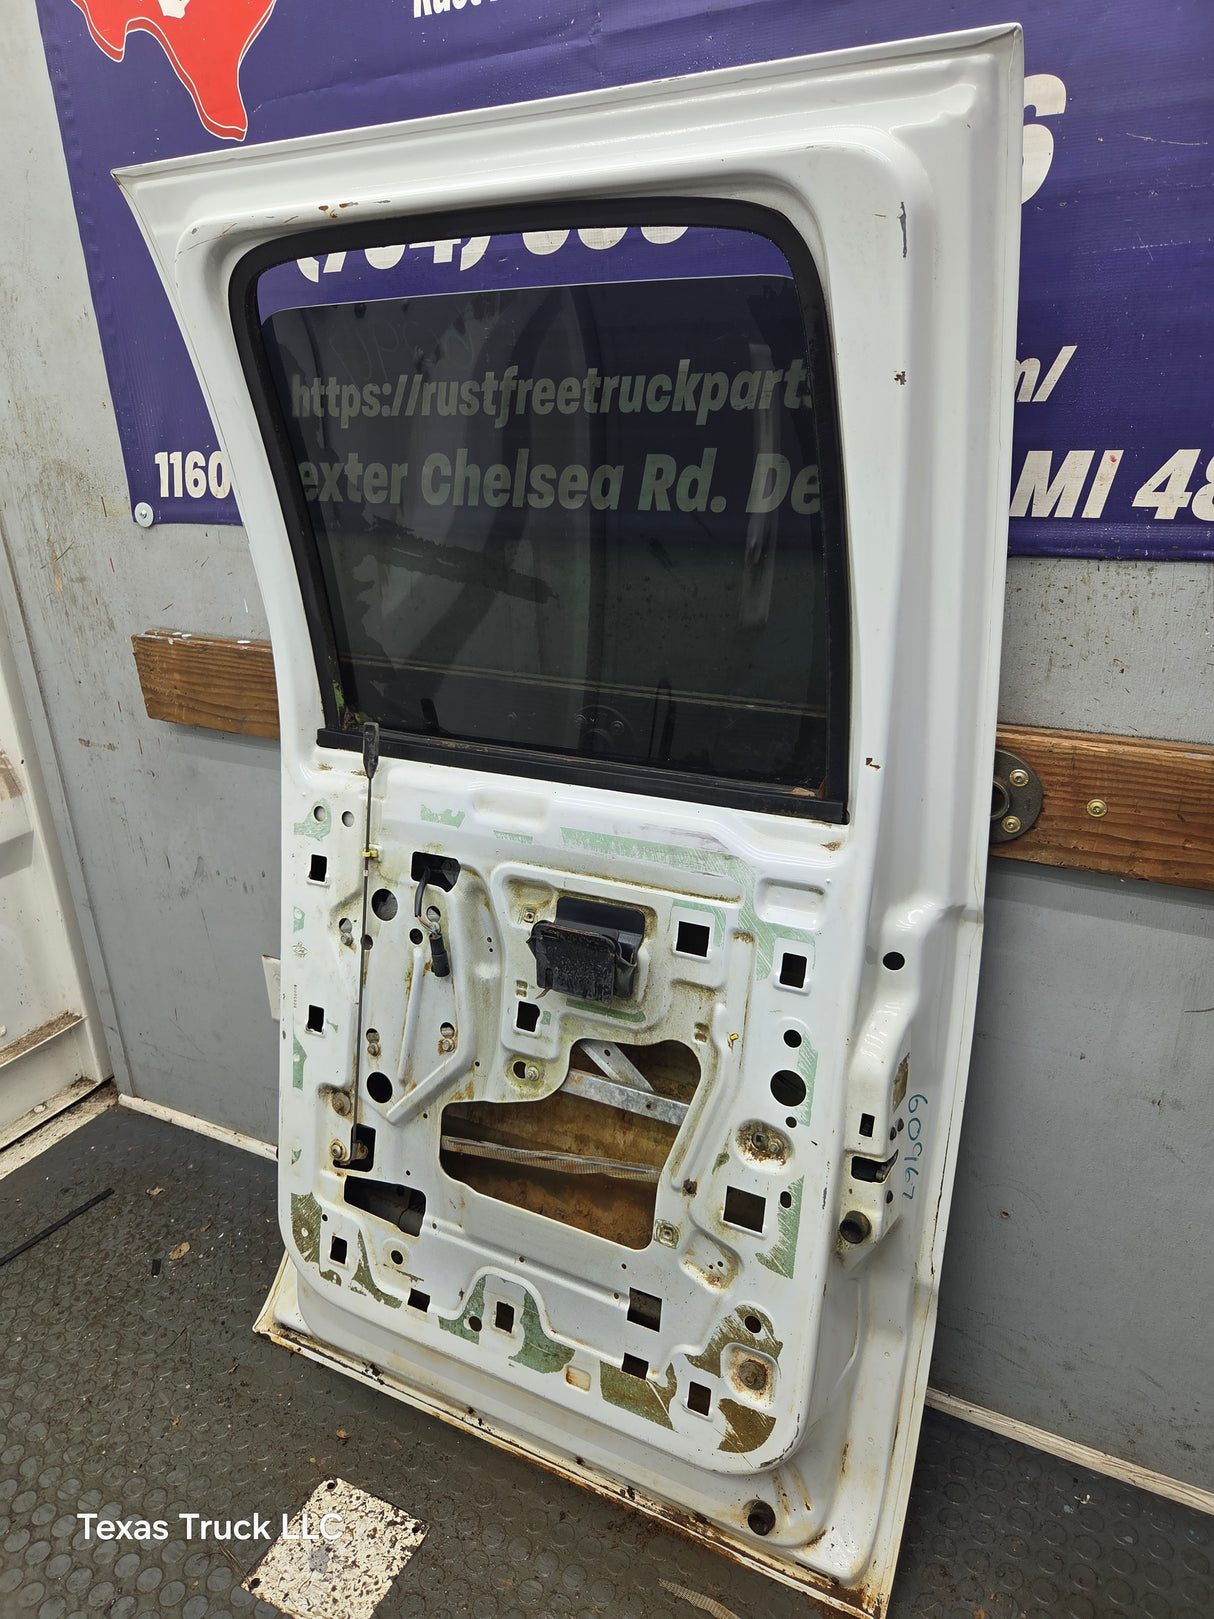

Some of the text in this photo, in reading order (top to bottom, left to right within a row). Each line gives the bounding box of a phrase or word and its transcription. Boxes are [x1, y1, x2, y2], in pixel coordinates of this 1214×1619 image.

[154, 450, 231, 499] 1160
[421, 448, 624, 511] Chelsea
[637, 447, 727, 513] Rd.
[1008, 449, 1124, 518] MI
